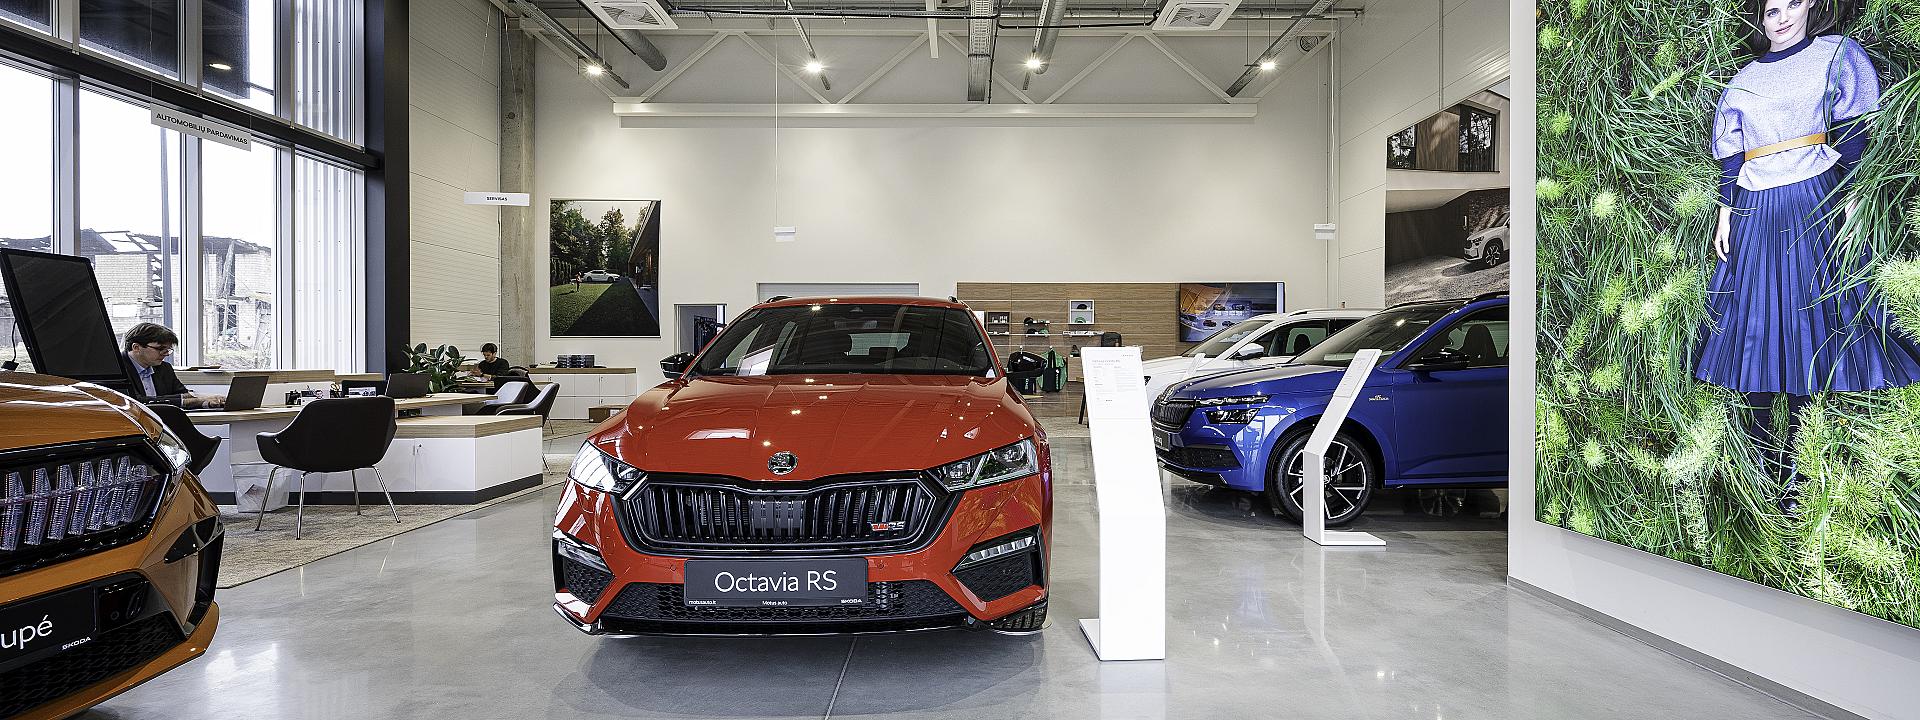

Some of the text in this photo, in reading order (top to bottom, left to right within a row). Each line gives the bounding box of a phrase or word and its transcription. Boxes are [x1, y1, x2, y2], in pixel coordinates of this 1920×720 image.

[156, 113, 248, 144] AUTOMOBILIŲ PARDAVIMAS
[714, 570, 838, 593] Octavia RS
